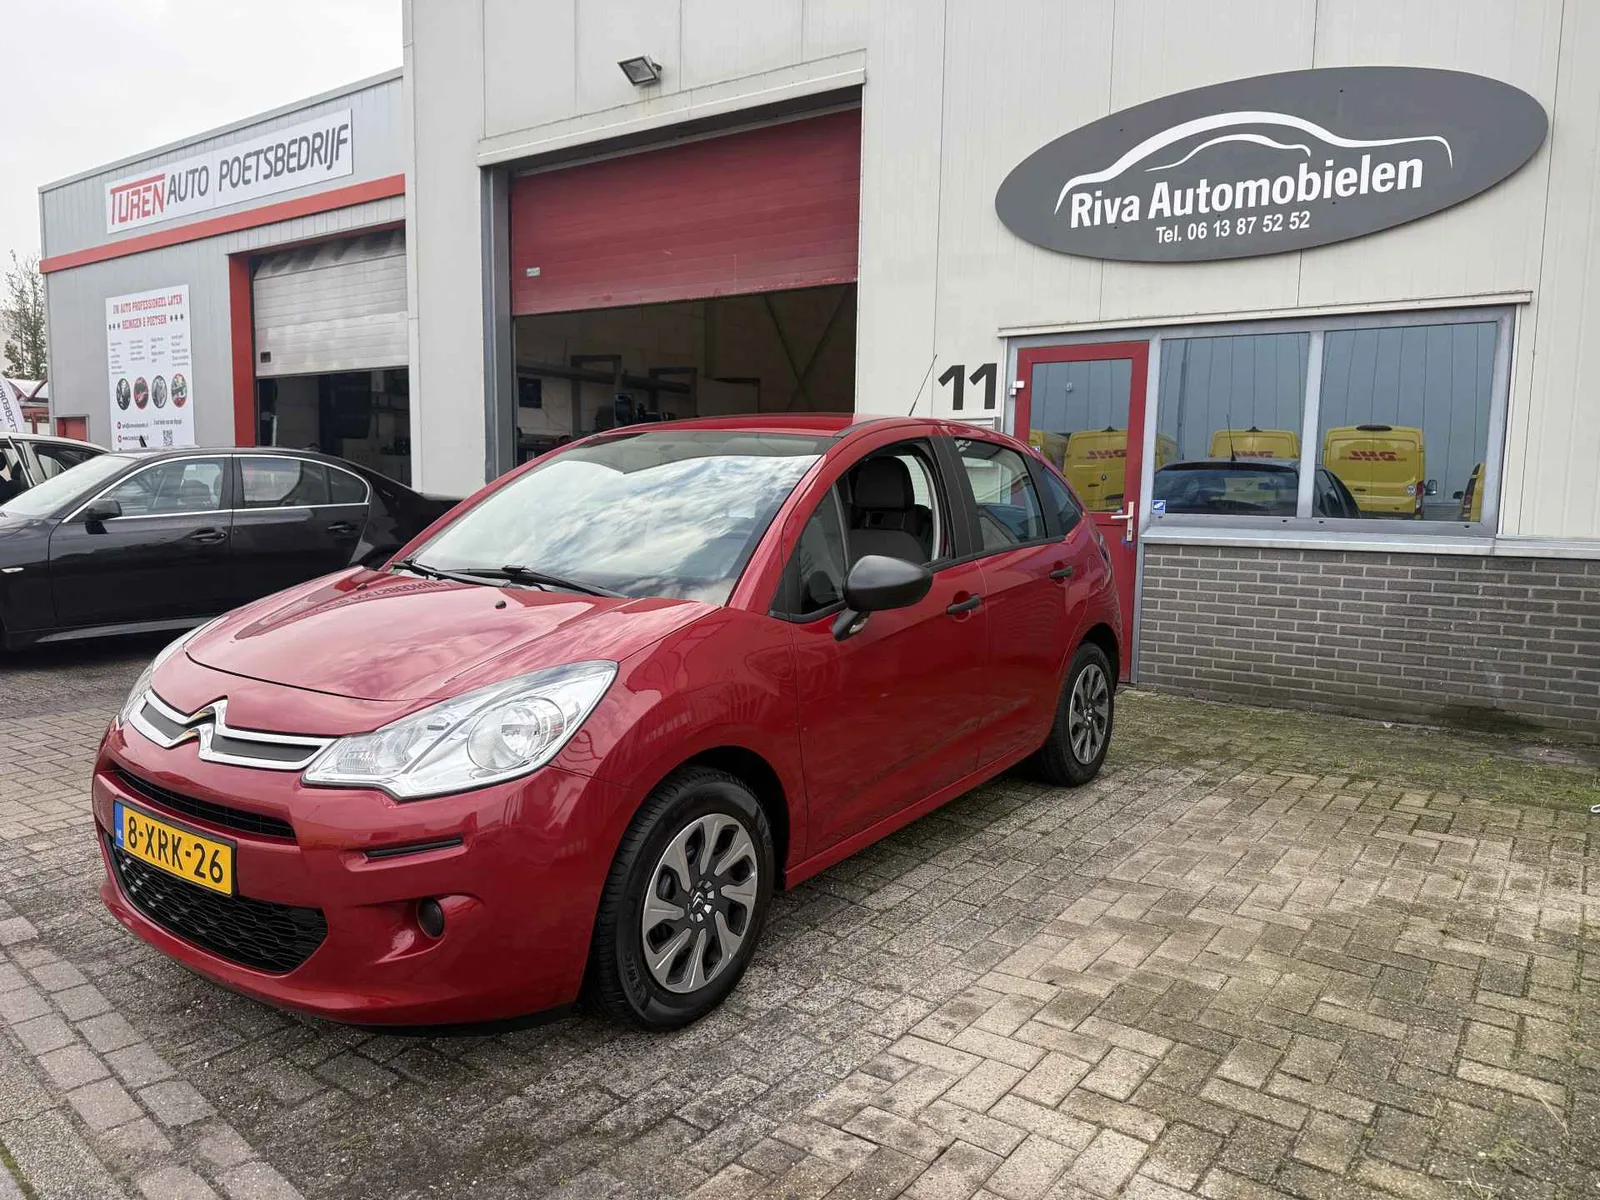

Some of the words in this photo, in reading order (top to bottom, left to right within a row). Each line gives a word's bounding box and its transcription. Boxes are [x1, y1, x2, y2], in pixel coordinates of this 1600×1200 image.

[110, 173, 166, 225] TUREN
[167, 165, 210, 205] AUTO
[218, 124, 349, 192] POETSBEDRIJF
[1070, 190, 1141, 229] Riva
[1148, 154, 1424, 219] Automobielen
[1155, 225, 1183, 244] Tel.
[1187, 221, 1208, 241] 06
[1212, 218, 1231, 238] 13
[1236, 216, 1256, 235] 87
[1262, 213, 1283, 232] 52
[1289, 210, 1311, 230] 52
[120, 302, 132, 314] AUTO
[167, 293, 183, 306] LATEN
[938, 363, 997, 410] 11
[128, 816, 224, 884] 8-XRK-26
